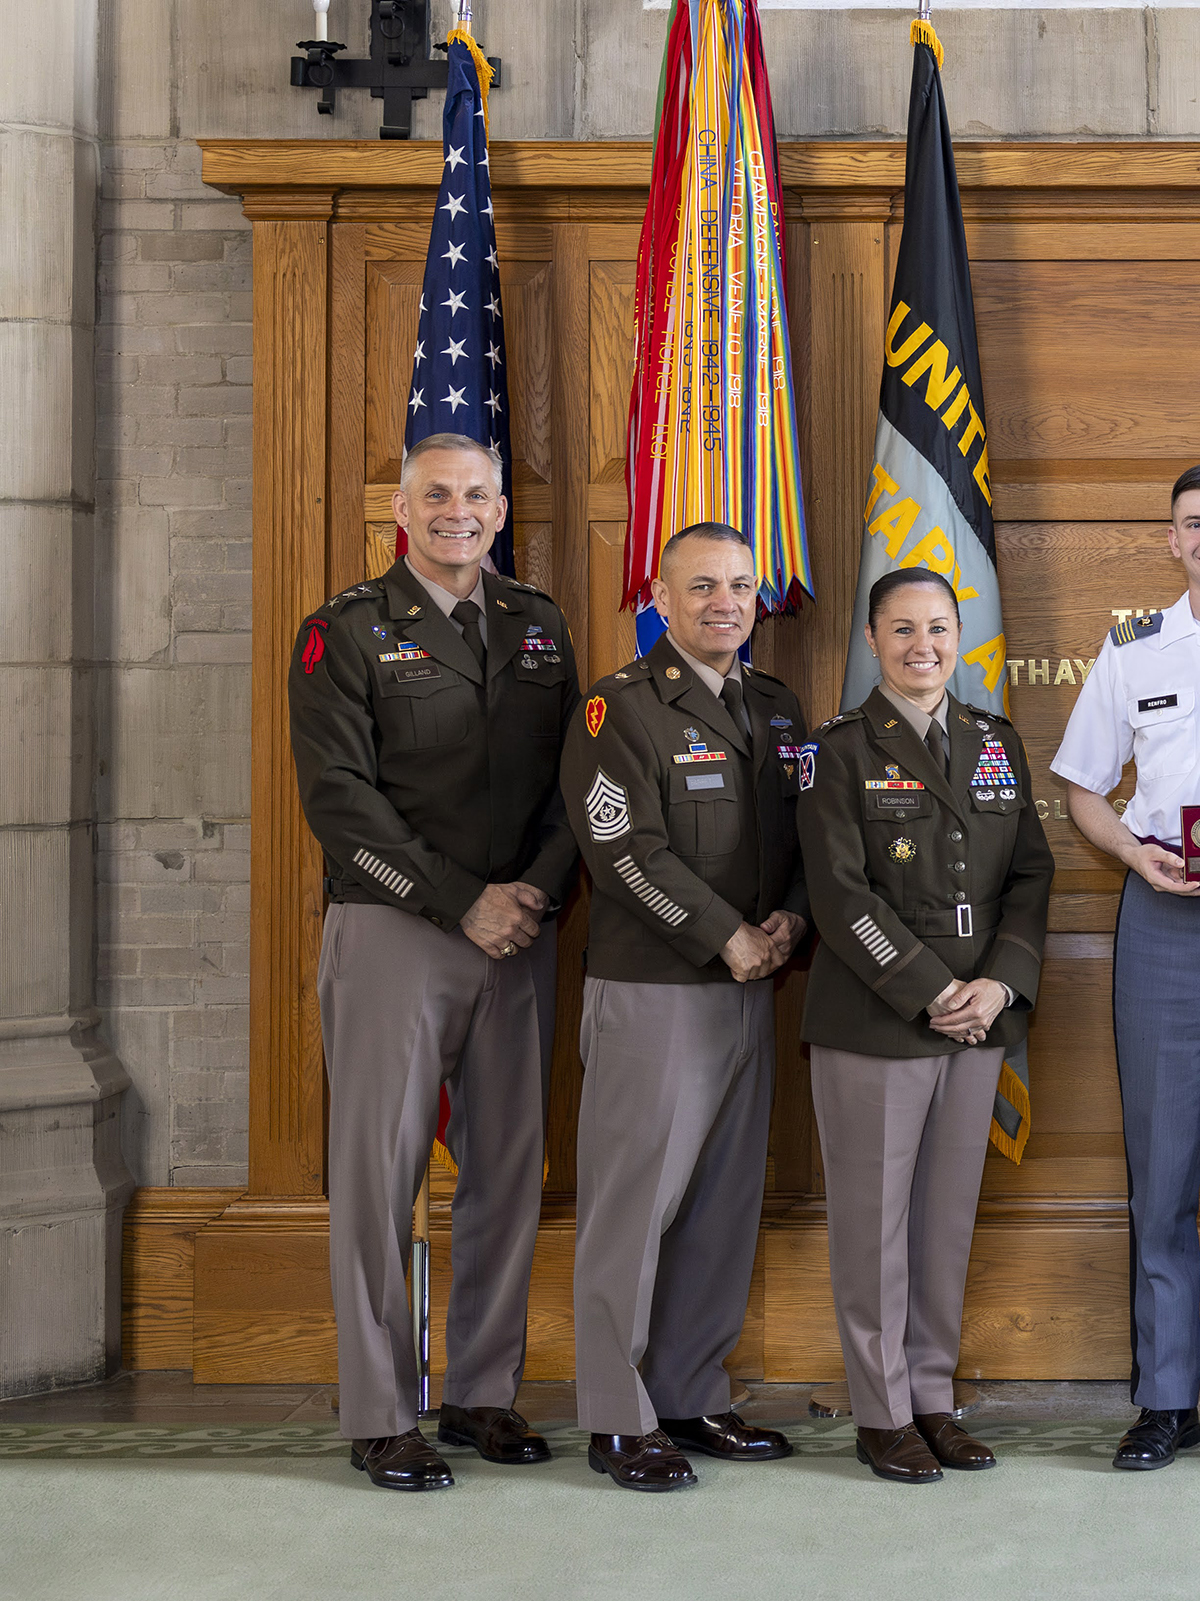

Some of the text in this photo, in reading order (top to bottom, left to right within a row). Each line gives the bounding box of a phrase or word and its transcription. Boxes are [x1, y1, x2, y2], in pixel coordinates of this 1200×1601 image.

[698, 129, 718, 191] CHINA
[700, 210, 720, 322] DEFENSIVE
[727, 158, 745, 408] VITTORIA VENETO 1918
[772, 355, 786, 391] 1918
[758, 392, 769, 427] 1918
[405, 669, 431, 677] GILLAND
[1147, 699, 1167, 708] RENFRO
[882, 797, 915, 805] ROBINSON
